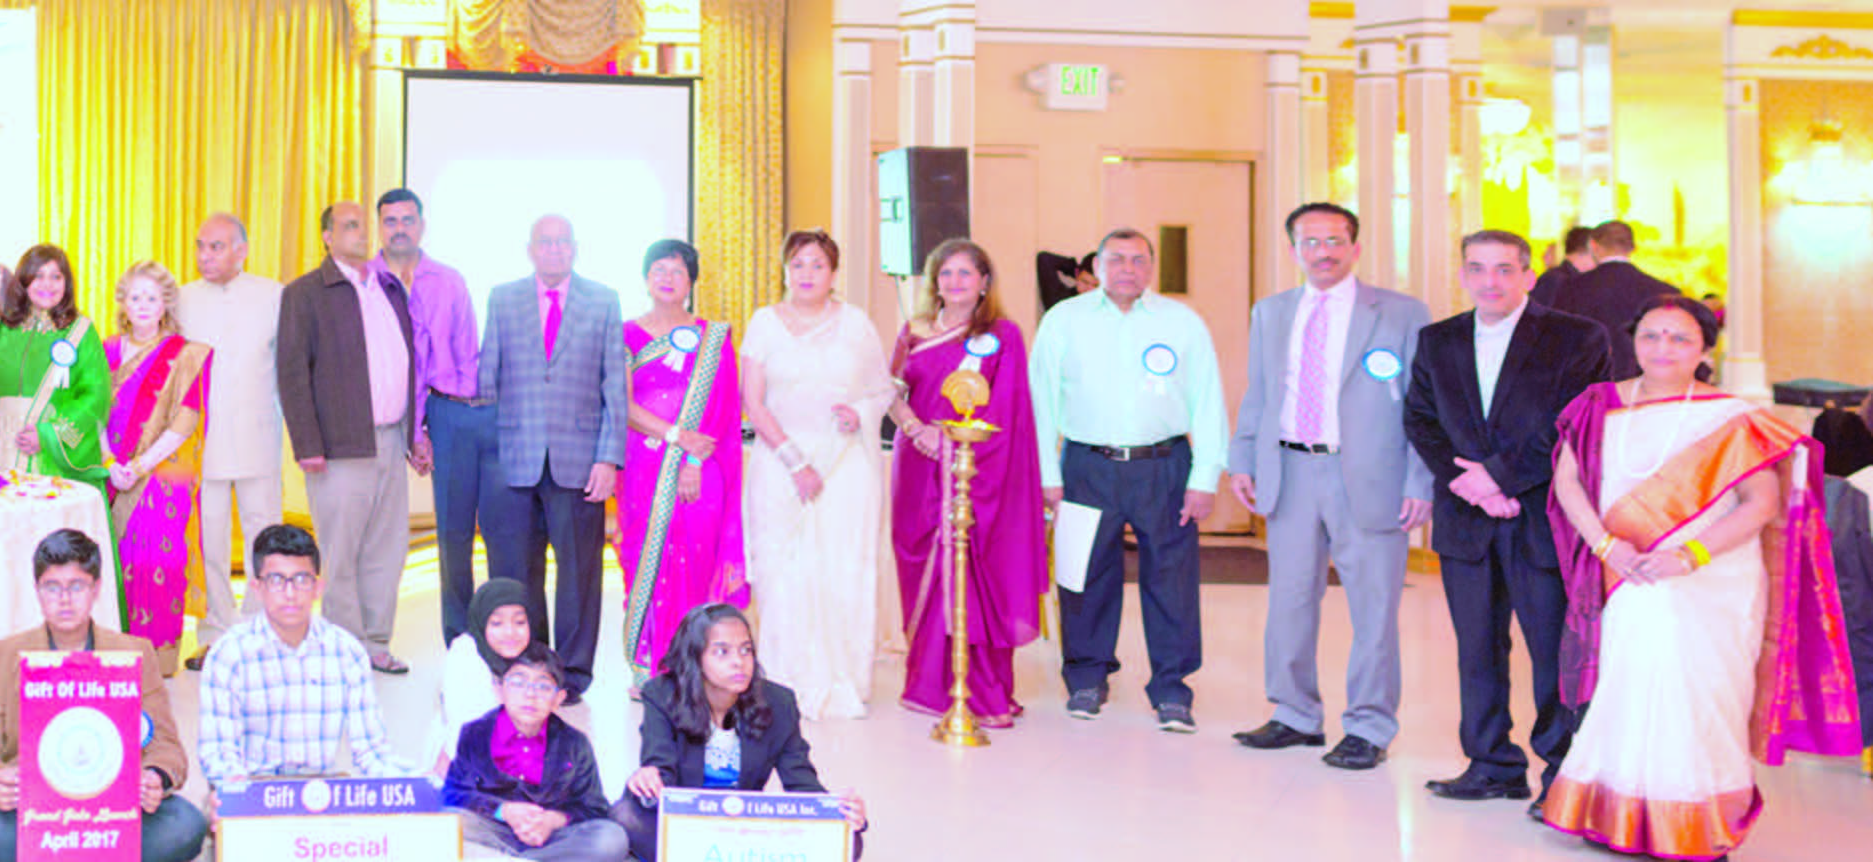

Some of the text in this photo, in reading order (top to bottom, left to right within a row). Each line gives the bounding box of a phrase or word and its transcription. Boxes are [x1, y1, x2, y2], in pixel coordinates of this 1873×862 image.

[1062, 66, 1102, 95] EXIT
[24, 681, 53, 698] Gift
[79, 681, 105, 698] Life
[110, 681, 138, 698] USA
[263, 785, 295, 809] Gift
[346, 784, 376, 807] Life
[382, 783, 416, 807] USA
[754, 802, 775, 815] Life
[778, 802, 798, 815] USA
[40, 830, 120, 853] April 2017
[294, 833, 388, 862] Special
[703, 843, 808, 862] Autism
